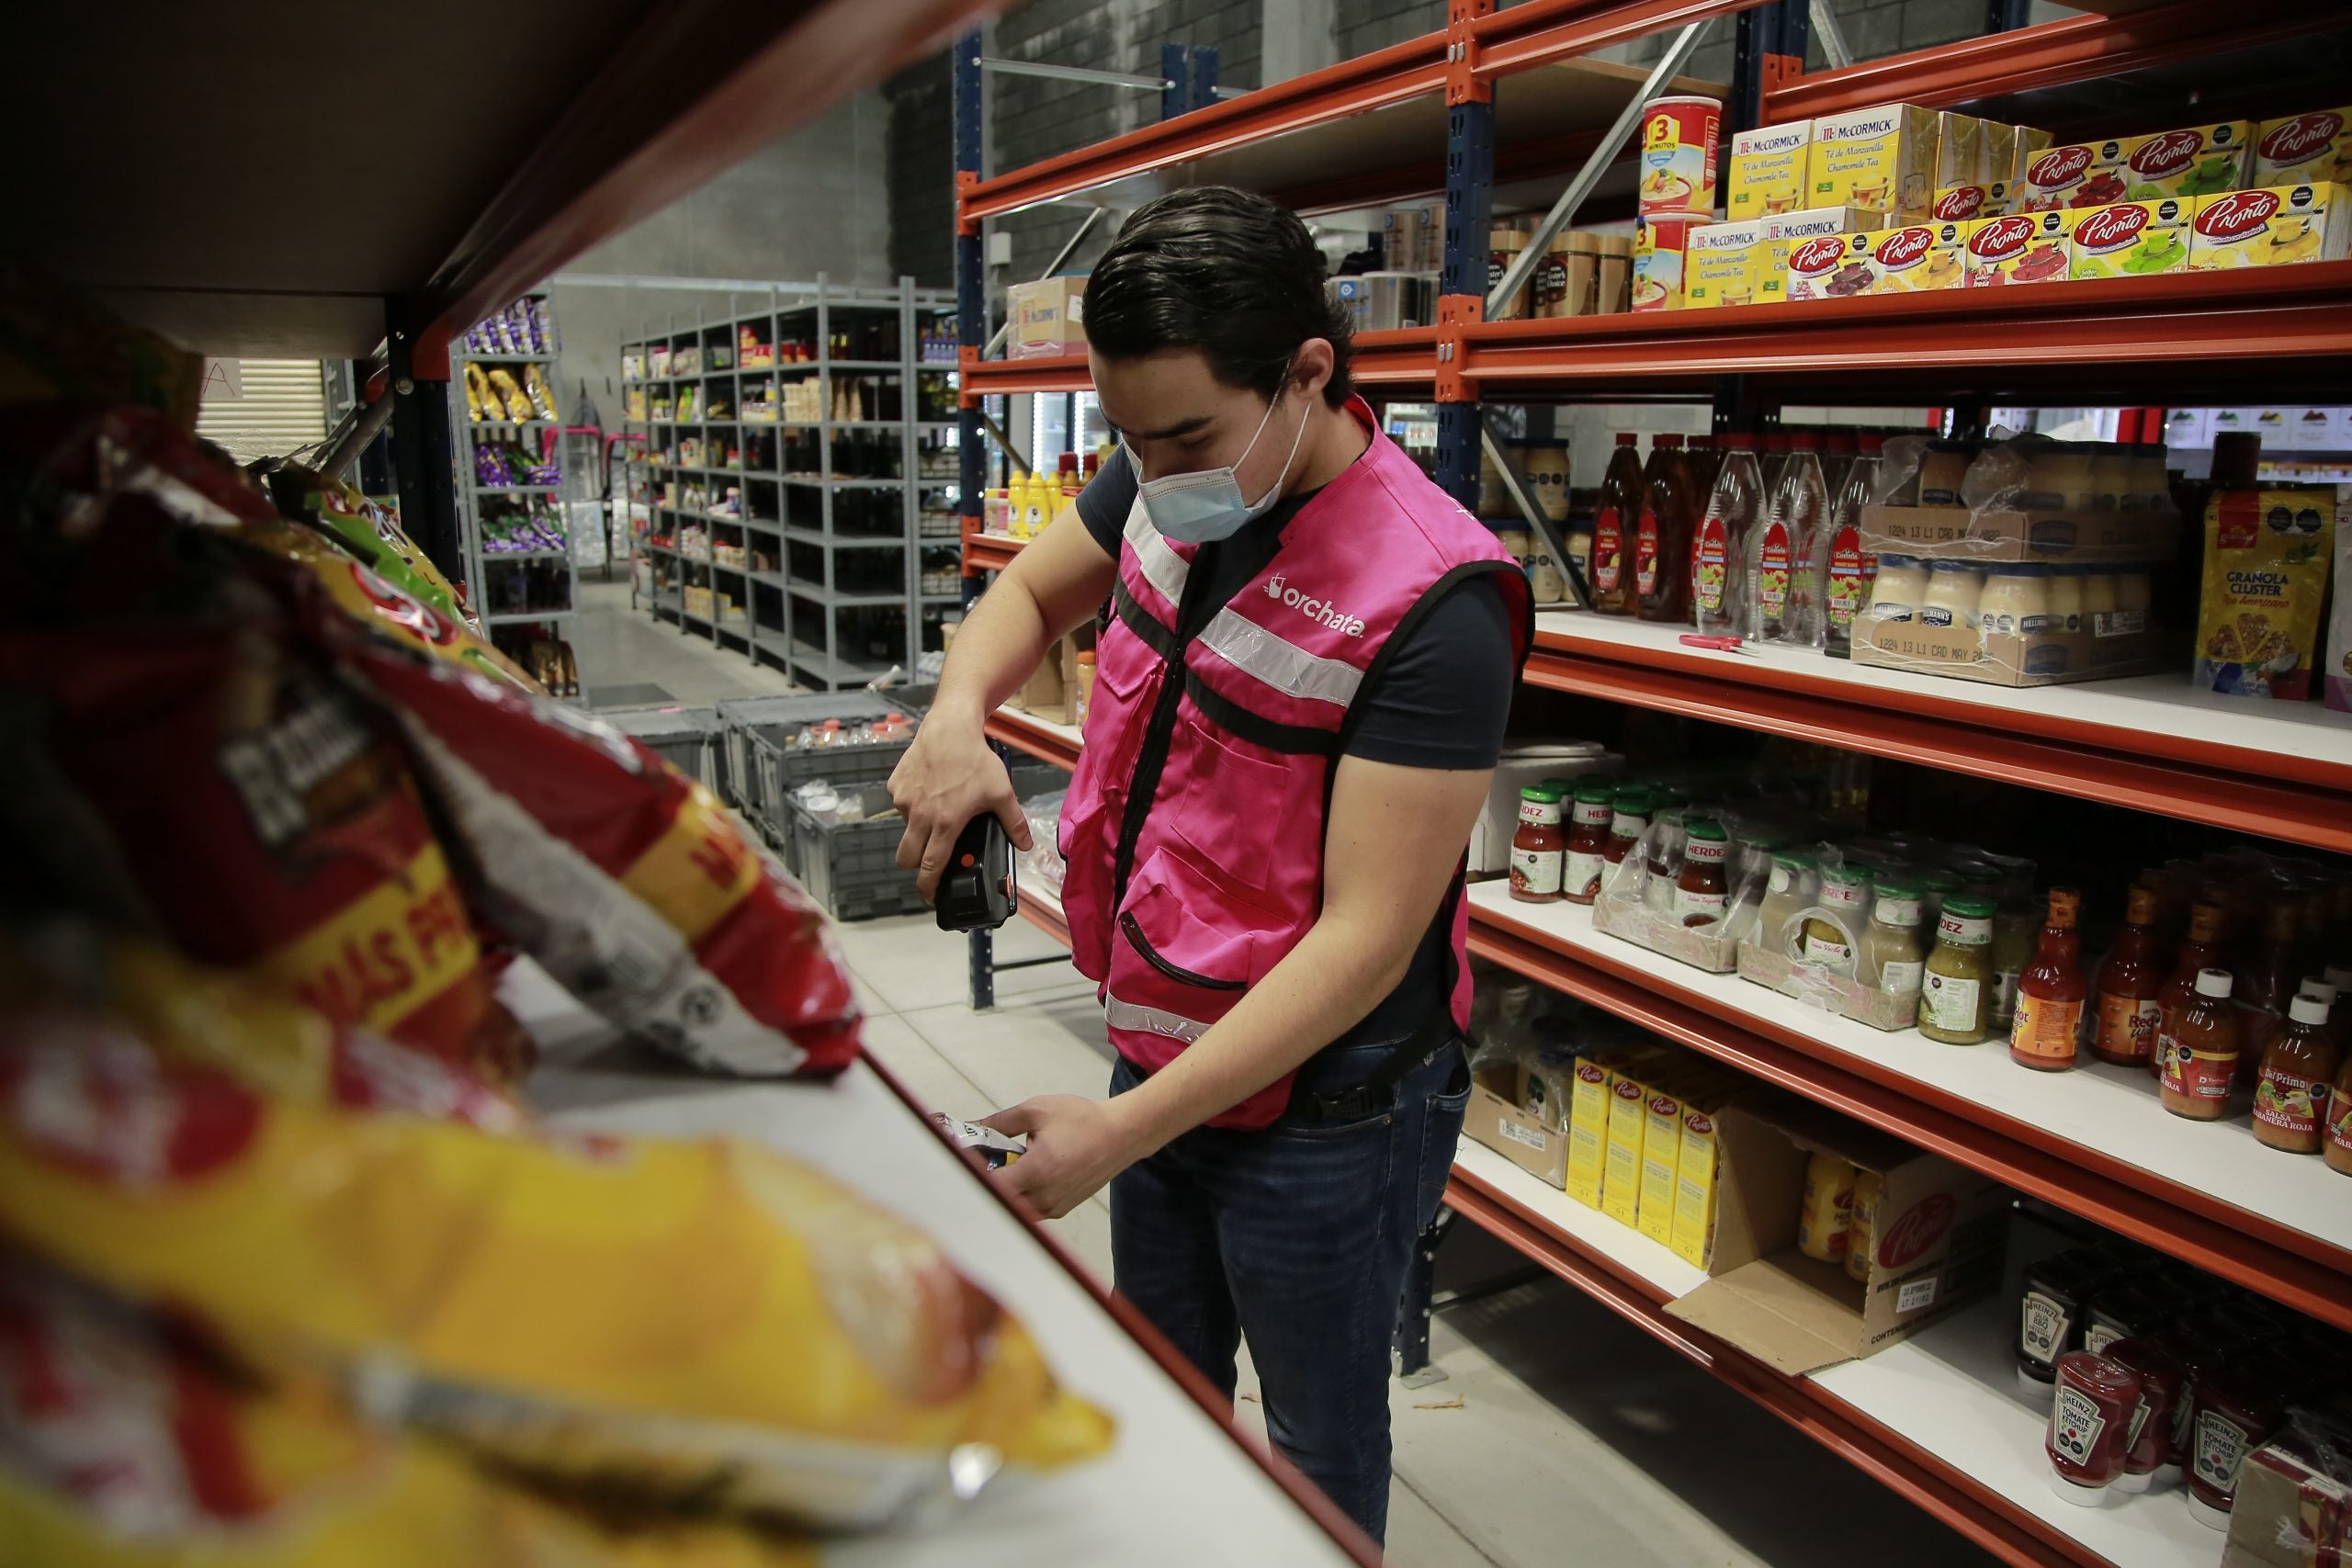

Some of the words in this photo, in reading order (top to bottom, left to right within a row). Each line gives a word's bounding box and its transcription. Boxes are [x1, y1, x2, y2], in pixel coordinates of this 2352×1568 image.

[1655, 119, 1668, 141] 3
[1838, 119, 1892, 139] McCORMICK
[1649, 142, 1676, 151] MINUTOS
[1754, 135, 1801, 152] McCORMICK
[1835, 148, 1843, 157] de
[1845, 142, 1883, 155] Manzanilla
[2135, 135, 2195, 171] Pronto
[1827, 161, 1864, 173] Chamomile
[1866, 158, 1879, 167] Tea
[2031, 150, 2087, 185] Pronto
[1937, 188, 1980, 220] Pronto
[2201, 195, 2272, 234] Pronto
[1784, 221, 1836, 238] McCORMICK
[2079, 208, 2142, 245] Pronto
[1637, 230, 1645, 247] 3
[1709, 233, 1755, 247] McCORMICK
[1973, 220, 2029, 254] Pronto
[1792, 239, 1840, 270] Pronto
[1880, 231, 1929, 266] Pronto
[1888, 525, 1905, 536] 1224
[1911, 526, 1920, 537] 13
[1938, 527, 1954, 539] CAD
[2226, 571, 2290, 585] GRANOLA
[2231, 583, 2282, 596] CLUSTER
[1283, 588, 1366, 637] orchata
[1879, 638, 1898, 650] 1224
[1903, 642, 1913, 653] 13
[1917, 644, 1927, 655] L1
[1931, 645, 1948, 658] CAD
[1951, 648, 1969, 660] MAY
[1823, 943, 1842, 954] Verde
[1577, 1066, 1601, 1082] Pronto
[2276, 1073, 2305, 1089] Primo
[1615, 1081, 1639, 1097] Pronto
[1650, 1097, 1675, 1113] Pronto
[1685, 1114, 1711, 1131] Pronto
[2266, 1109, 2291, 1122] SALSA
[2290, 1122, 2313, 1132] ROJA
[2032, 1303, 2055, 1318] HEINZ
[2033, 1316, 2049, 1330] BBQ
[2066, 1395, 2091, 1416] HEINZ
[2062, 1415, 2088, 1434] KETCHUP
[2063, 1405, 2091, 1429] TOMATE
[2208, 1420, 2237, 1440] HEINZ
[2203, 1440, 2235, 1460] KETCHUP
[2204, 1430, 2237, 1454] TOMATE
